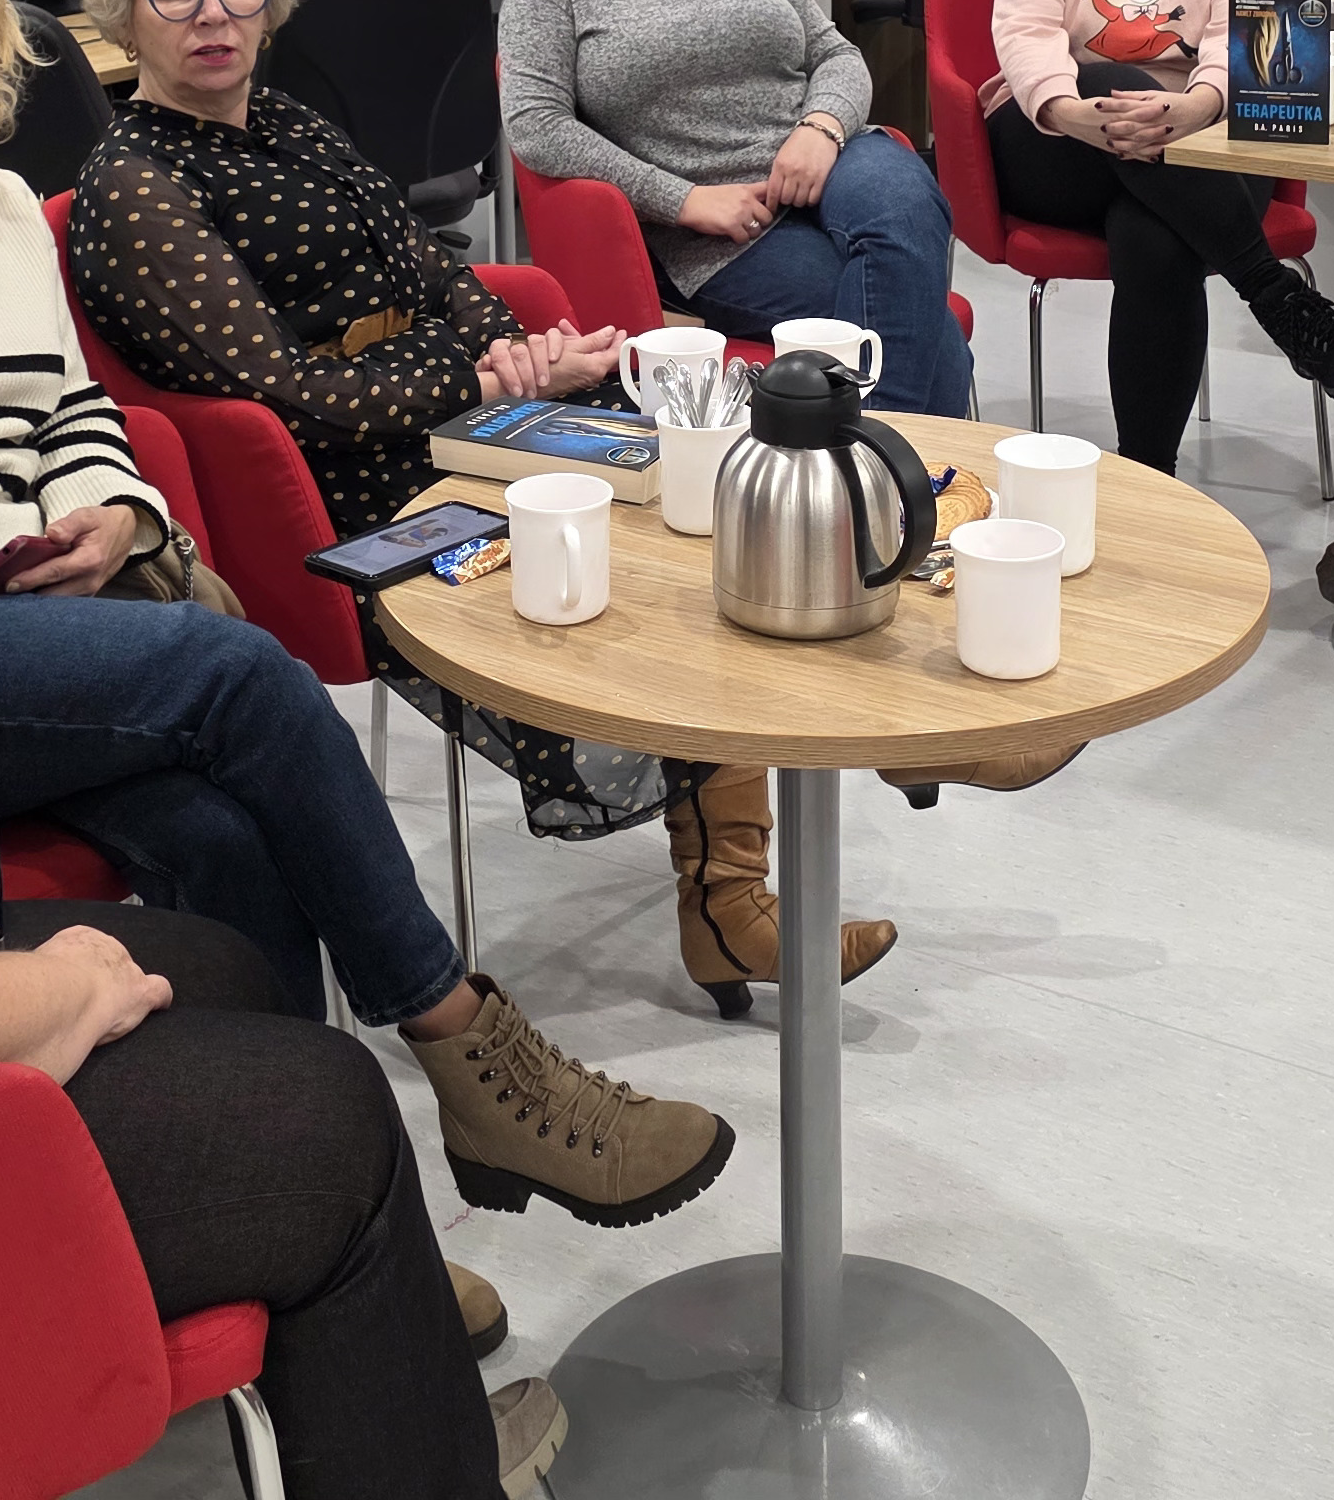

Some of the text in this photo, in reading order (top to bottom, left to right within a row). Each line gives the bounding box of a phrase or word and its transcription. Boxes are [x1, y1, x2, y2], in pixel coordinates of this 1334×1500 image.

[1235, 102, 1323, 121] TERAPEUTKA
[1272, 123, 1303, 133] PARIS
[468, 400, 552, 438] TERAPEUTKA
